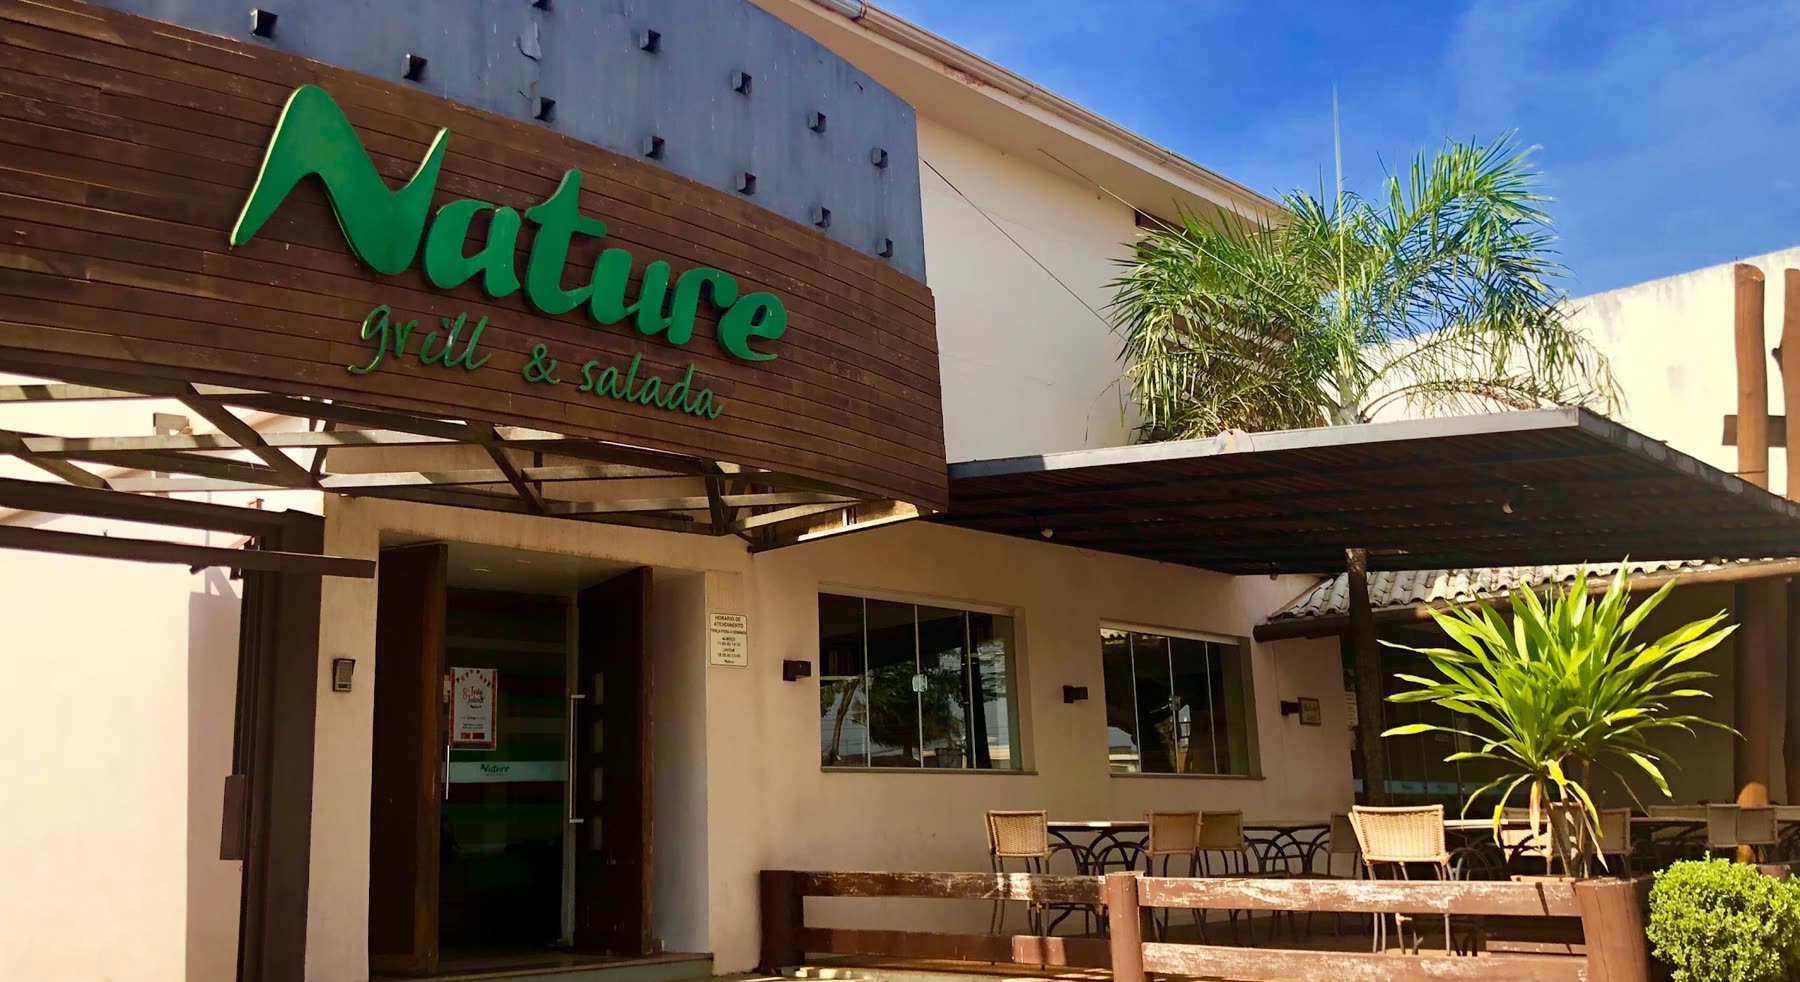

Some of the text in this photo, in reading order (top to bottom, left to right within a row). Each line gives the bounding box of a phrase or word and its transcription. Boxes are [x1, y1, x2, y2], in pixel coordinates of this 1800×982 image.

[229, 84, 788, 362] Nature
[347, 304, 724, 420] grill & salada
[480, 764, 510, 773] Nature
